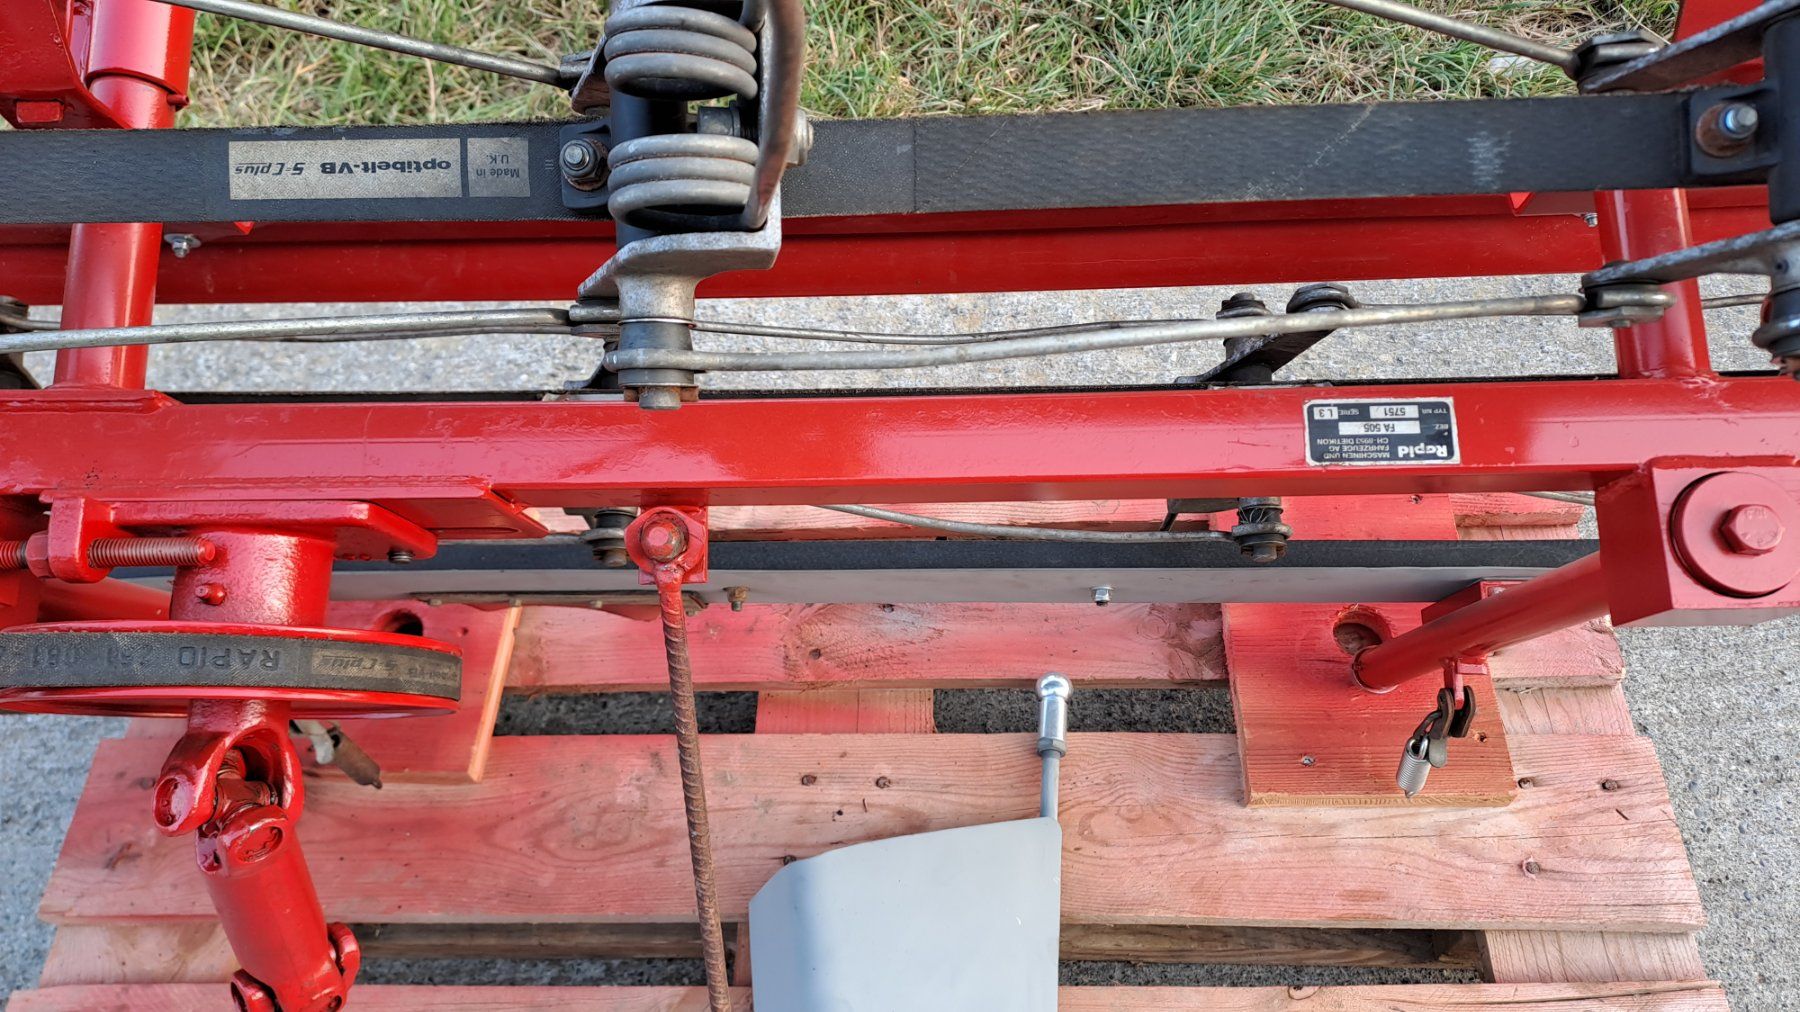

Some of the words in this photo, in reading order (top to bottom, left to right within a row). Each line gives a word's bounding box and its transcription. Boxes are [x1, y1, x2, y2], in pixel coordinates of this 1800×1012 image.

[486, 154, 509, 165] U.K.
[320, 158, 452, 174] optibelt-VB
[476, 168, 487, 178] in
[490, 167, 520, 178] Made
[1383, 407, 1406, 416] 5751
[1363, 423, 1382, 432] 505
[1383, 423, 1396, 432] FA
[1398, 443, 1448, 458] Rapid
[178, 646, 281, 672] RAPID
